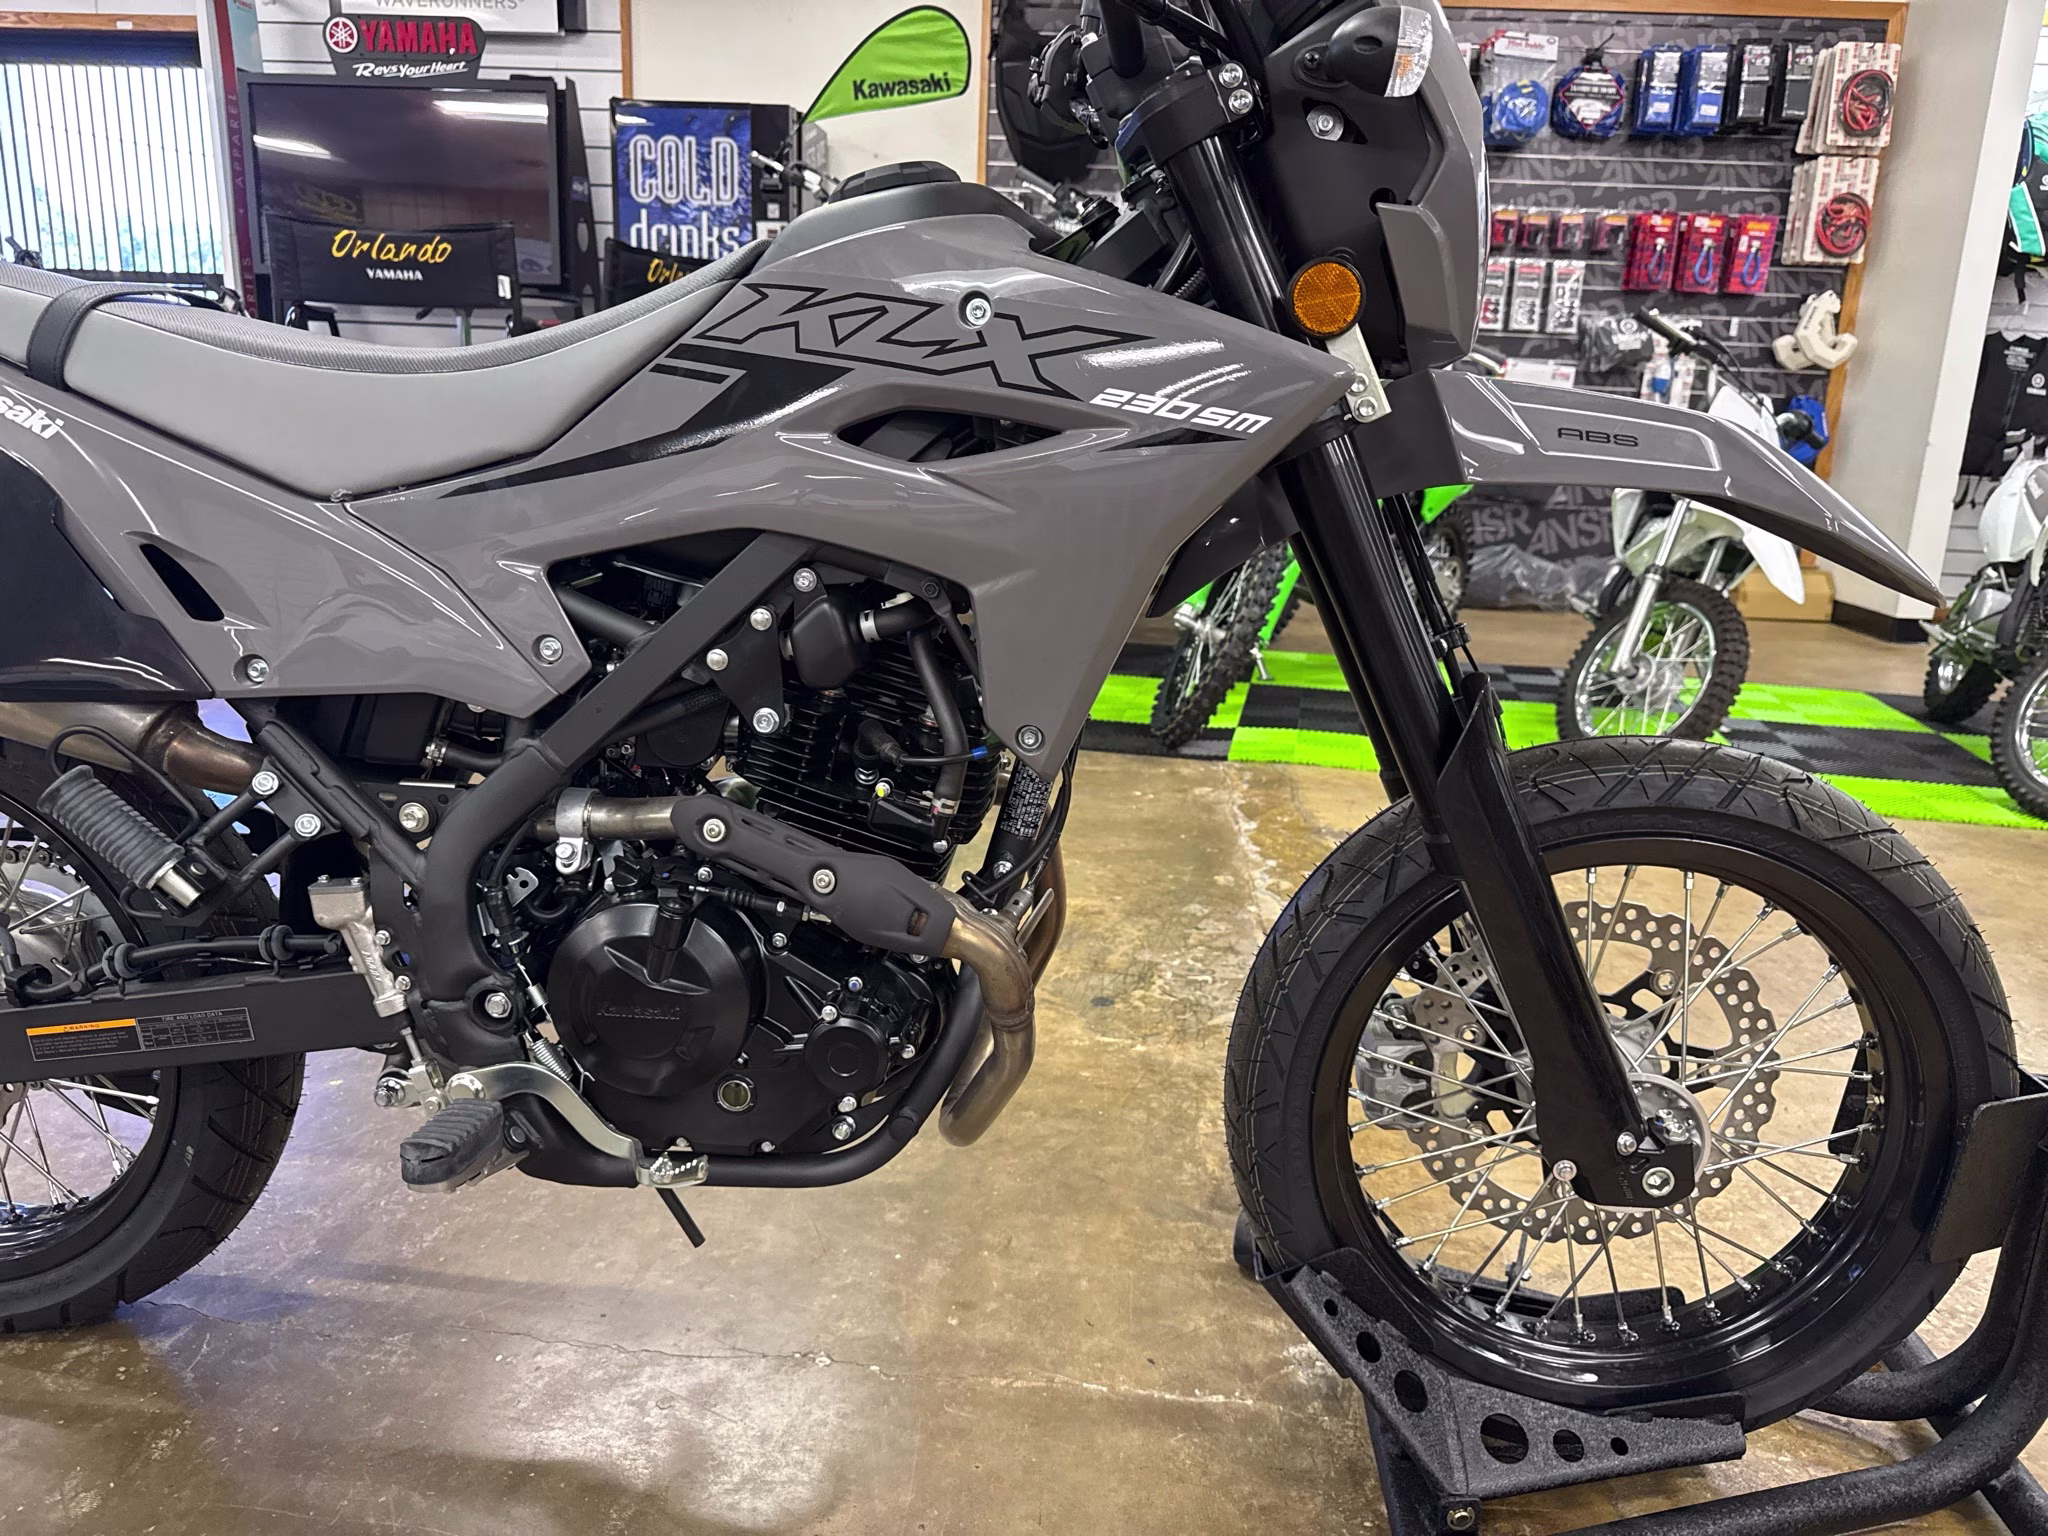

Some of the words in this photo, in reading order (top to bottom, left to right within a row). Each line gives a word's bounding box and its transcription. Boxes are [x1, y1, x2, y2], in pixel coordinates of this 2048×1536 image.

[360, 19, 477, 55] YAMAHA
[352, 62, 398, 77] Revs
[399, 64, 432, 77] Your
[431, 61, 466, 74] Heart
[852, 72, 951, 101] Kawasaki
[629, 134, 739, 206] COLD
[331, 229, 452, 264] Orlando
[629, 208, 740, 260] drinks
[366, 267, 423, 281] YAMAHA
[695, 282, 1156, 402] KLX
[1089, 387, 1273, 433] 230SM
[1557, 427, 1639, 447] ABS
[68, 1023, 100, 1031] WARNING
